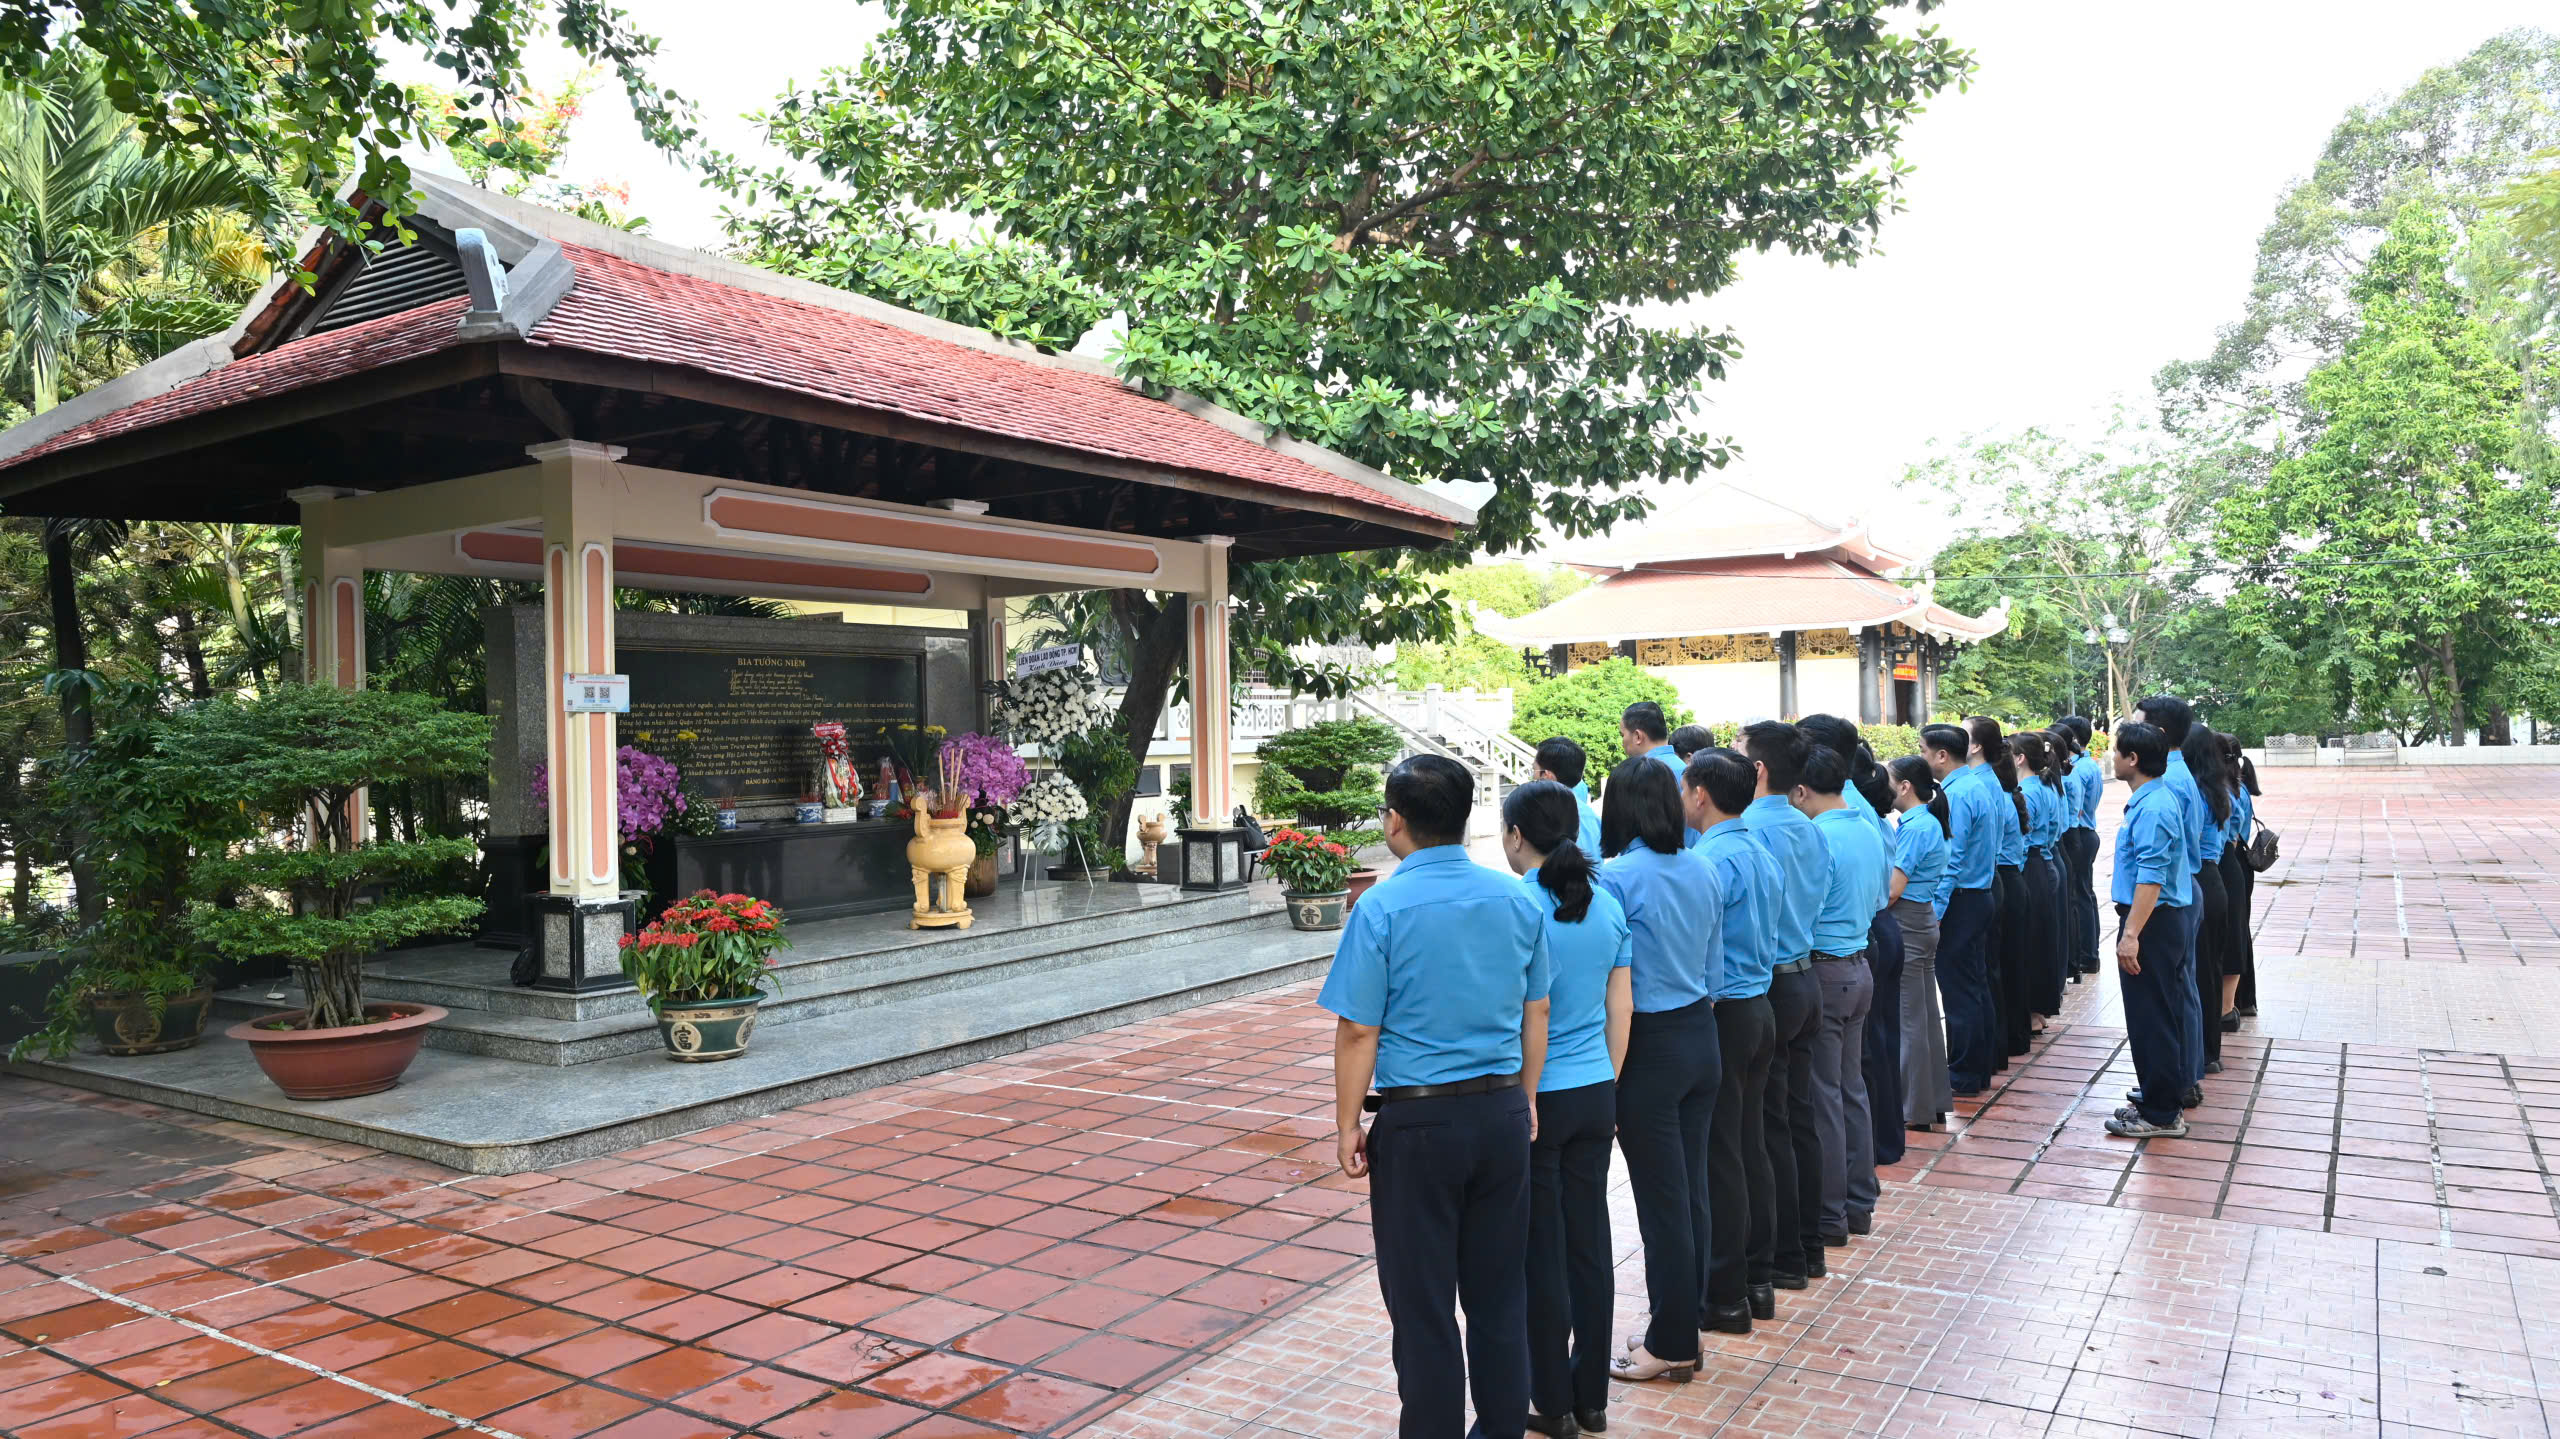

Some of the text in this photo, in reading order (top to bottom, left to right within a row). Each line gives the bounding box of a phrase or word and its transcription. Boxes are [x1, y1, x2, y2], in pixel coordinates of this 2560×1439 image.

[737, 656, 806, 669] BIA TƯỞNG NIỆM
[1019, 654, 1028, 666] LIÊN
[1029, 652, 1040, 664] ĐOÀN
[1049, 648, 1061, 661] ĐỘNG
[674, 1025, 692, 1050] 富
